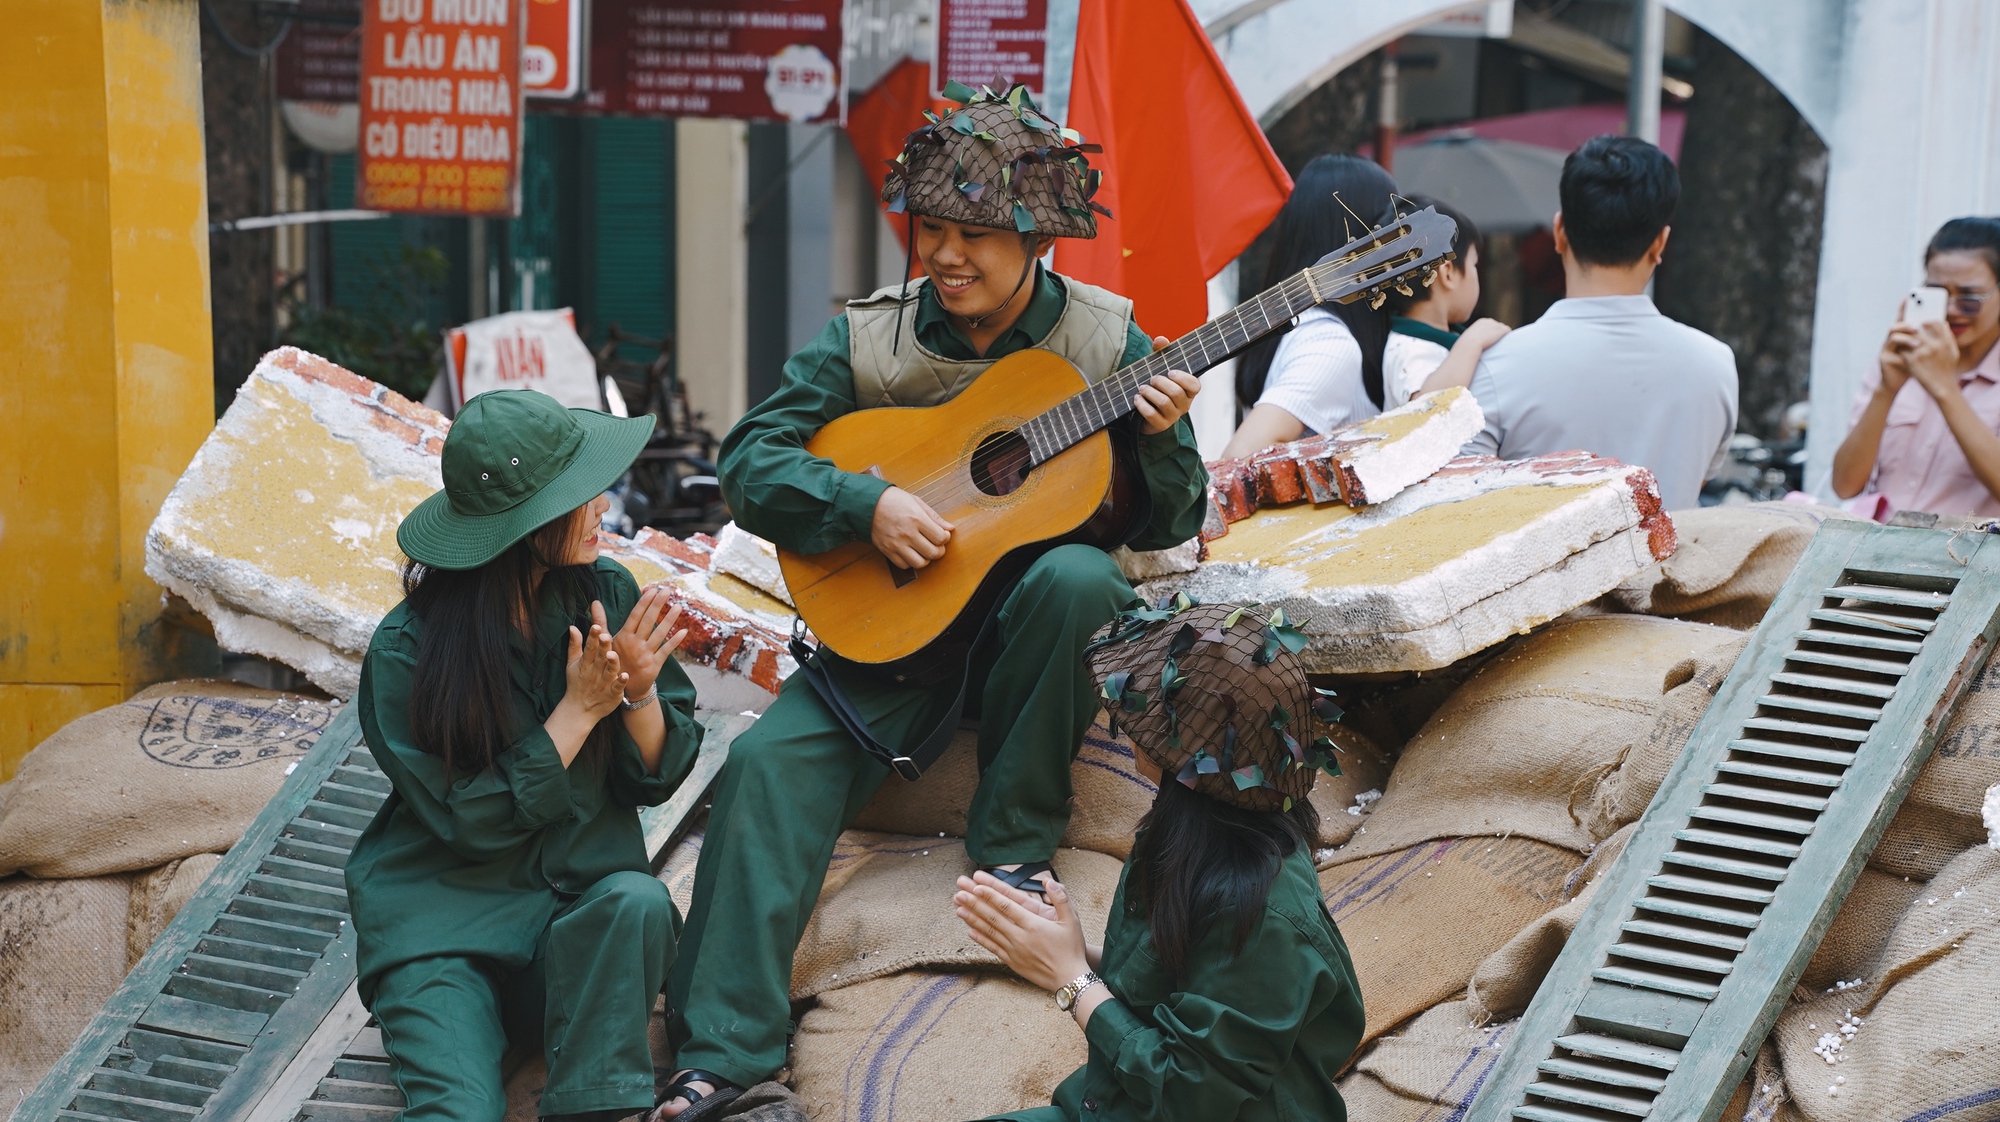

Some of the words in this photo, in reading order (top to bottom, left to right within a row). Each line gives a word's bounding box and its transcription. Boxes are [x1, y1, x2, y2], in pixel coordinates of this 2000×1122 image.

[452, 29, 500, 71] ĂN
[368, 76, 453, 114] TRONG
[458, 73, 513, 116] NHÀ
[365, 116, 399, 157] CÓ
[461, 119, 511, 162] HÒA
